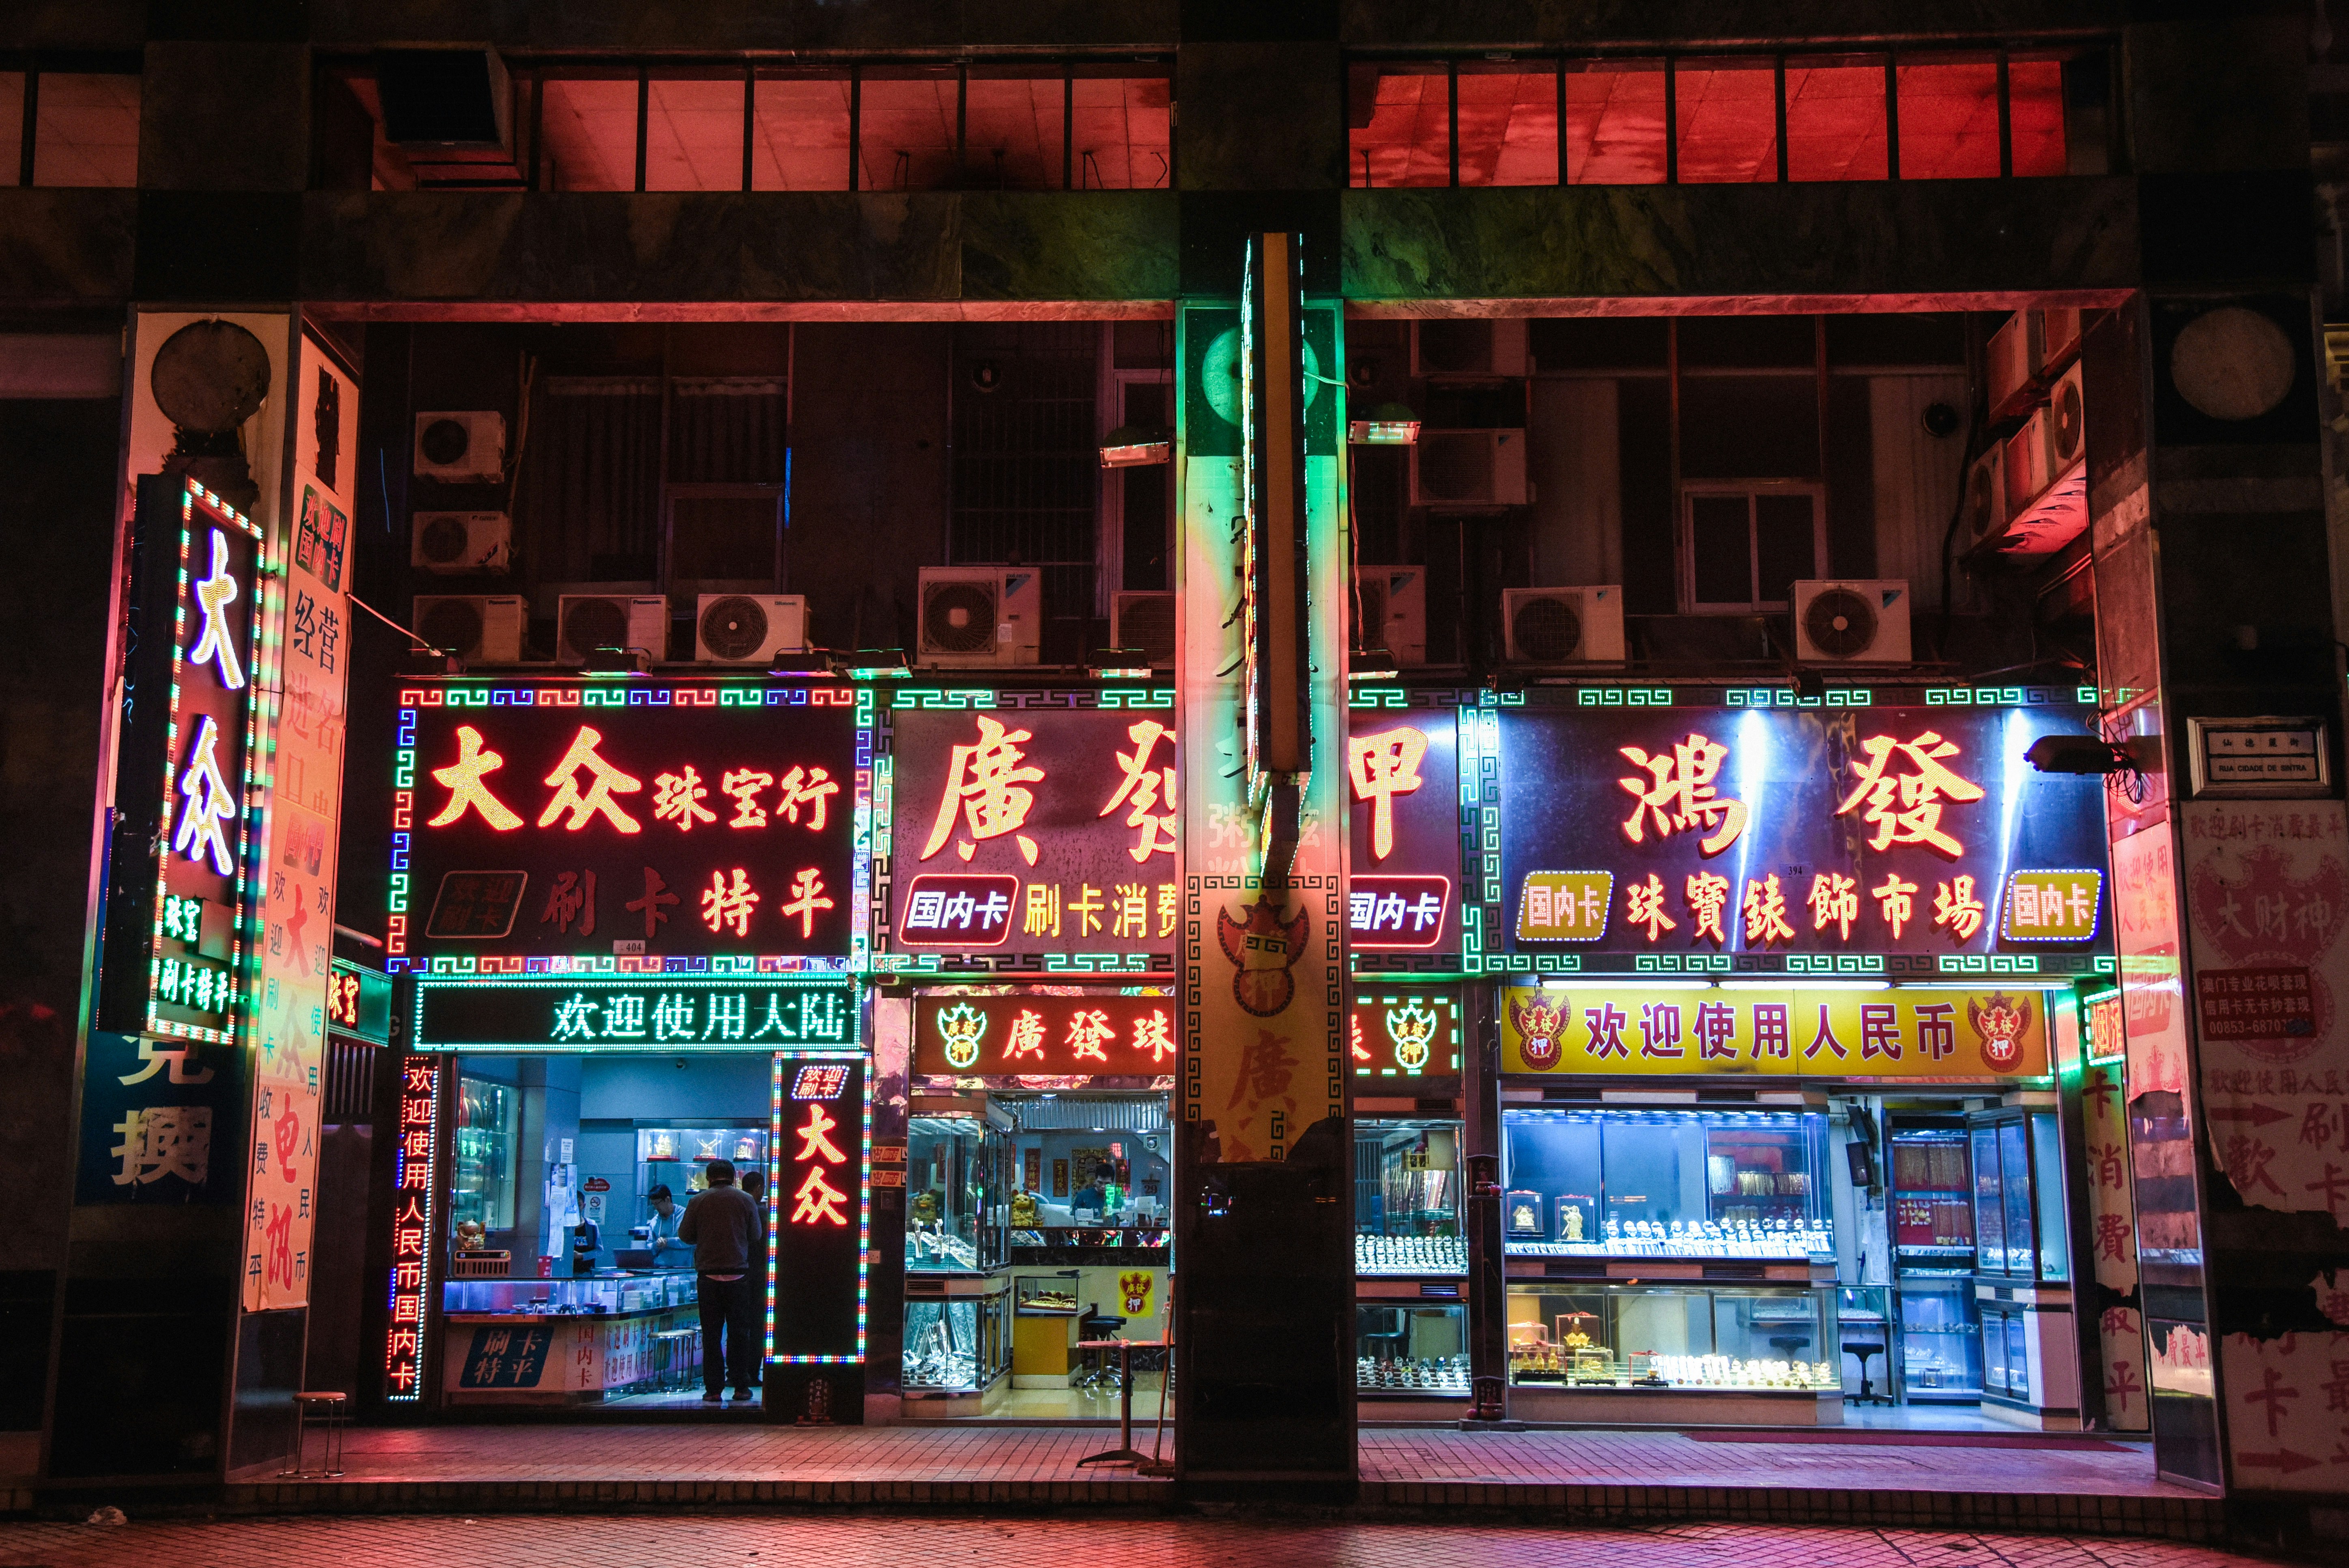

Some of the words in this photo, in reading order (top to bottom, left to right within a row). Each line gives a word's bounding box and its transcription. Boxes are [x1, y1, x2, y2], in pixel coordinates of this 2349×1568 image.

[303, 494, 345, 552] 欢迎刷
[298, 526, 340, 585] 国内卡
[293, 589, 339, 675] 经营
[174, 526, 244, 875] 大众
[427, 725, 839, 833] 大众珠宝行
[1619, 730, 1985, 858] 鴻發
[1788, 866, 1803, 876] 394
[164, 895, 200, 942] 珠宝
[541, 867, 834, 938] 刷卡特平
[906, 891, 1010, 929] 国内卡
[1528, 885, 1600, 927] 国内卡
[2013, 883, 2091, 927] 国内卡
[626, 942, 641, 952] 404
[161, 958, 228, 1013] 刷卡特平
[1531, 1037, 1549, 1055] 押
[1584, 1000, 1957, 1062] 欢迎使用人民币
[1992, 1039, 2009, 1057] 押
[798, 1083, 837, 1096] 刷卡
[804, 1068, 842, 1082] 欢迎
[792, 1103, 847, 1225] 大众
[389, 1065, 433, 1389] 欢迎使用人民币国内卡
[1128, 1297, 1141, 1312] 押
[481, 1329, 543, 1356] 刷卡
[576, 1324, 595, 1388] 国内卡
[474, 1357, 535, 1384] 特平
